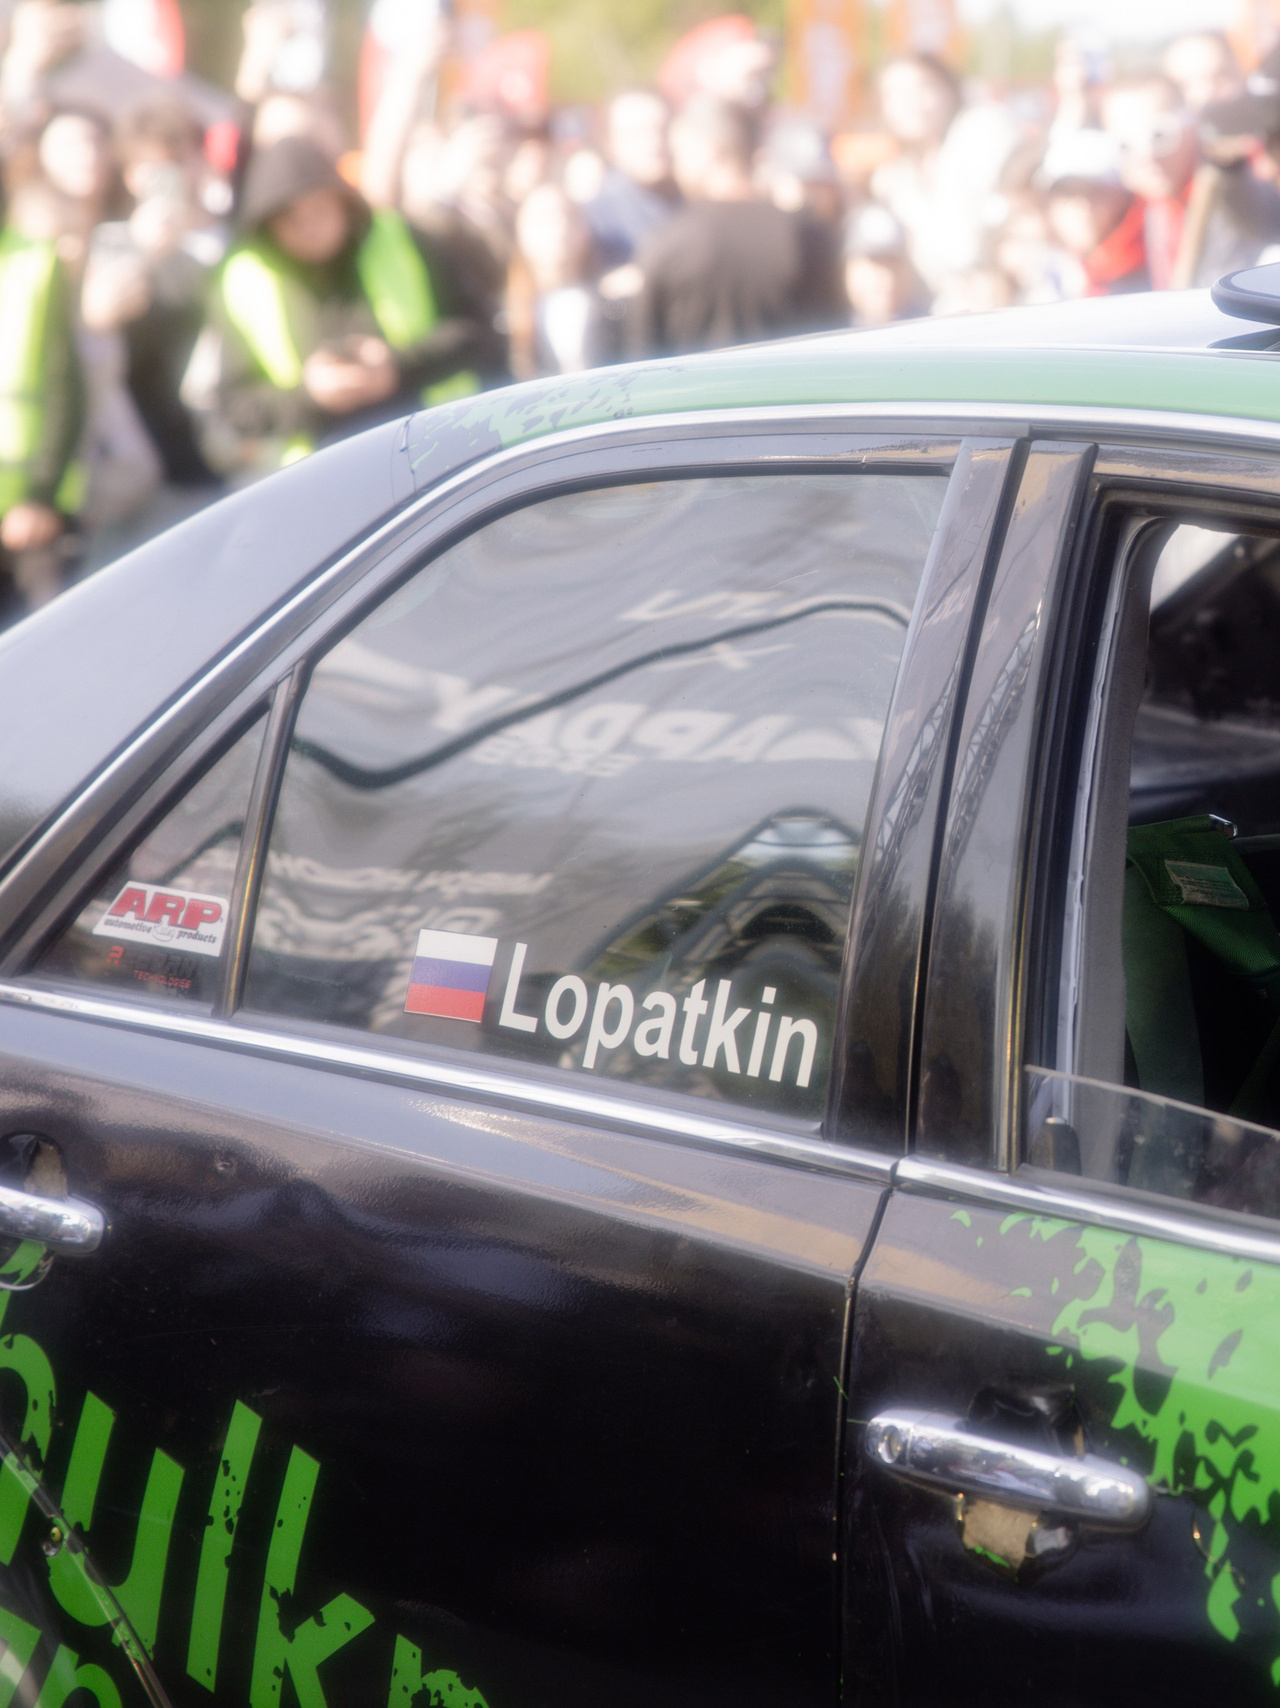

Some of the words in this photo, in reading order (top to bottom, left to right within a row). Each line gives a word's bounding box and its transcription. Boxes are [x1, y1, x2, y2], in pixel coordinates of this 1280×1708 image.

[108, 887, 223, 930] ARP
[103, 917, 152, 934] automotive
[175, 929, 217, 945] products
[498, 942, 819, 1088] Lopatkin
